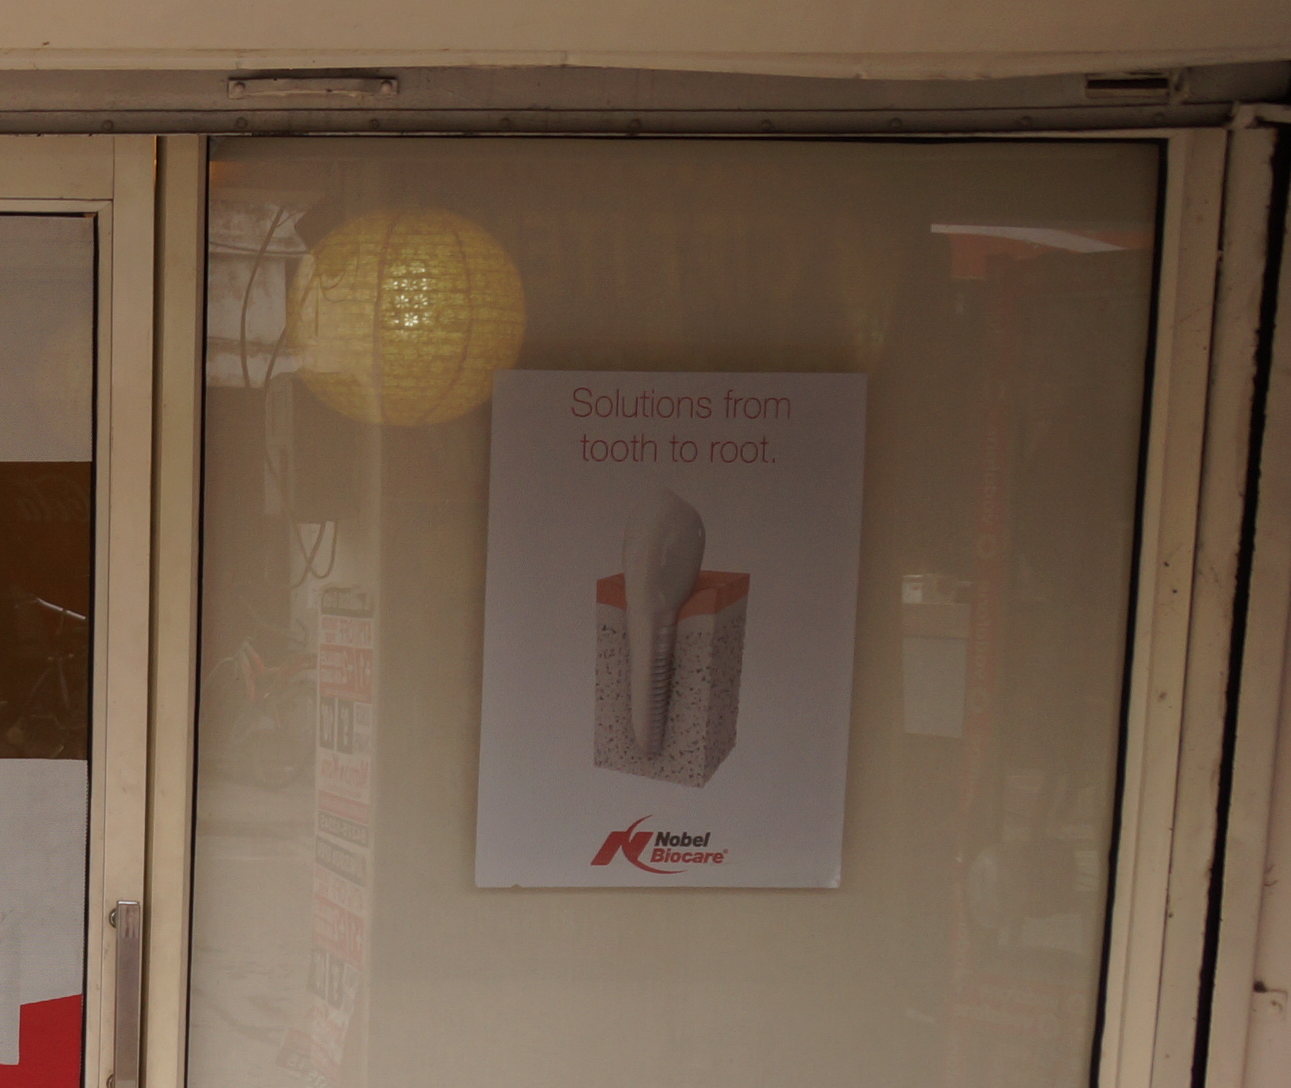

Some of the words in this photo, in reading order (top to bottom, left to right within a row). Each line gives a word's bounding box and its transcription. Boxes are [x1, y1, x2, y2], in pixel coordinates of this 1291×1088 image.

[570, 387, 713, 421] Solutions
[723, 387, 792, 421] from
[579, 432, 659, 464] tooth
[669, 434, 699, 464] to
[709, 436, 778, 464] root.
[653, 831, 712, 848] Nobel
